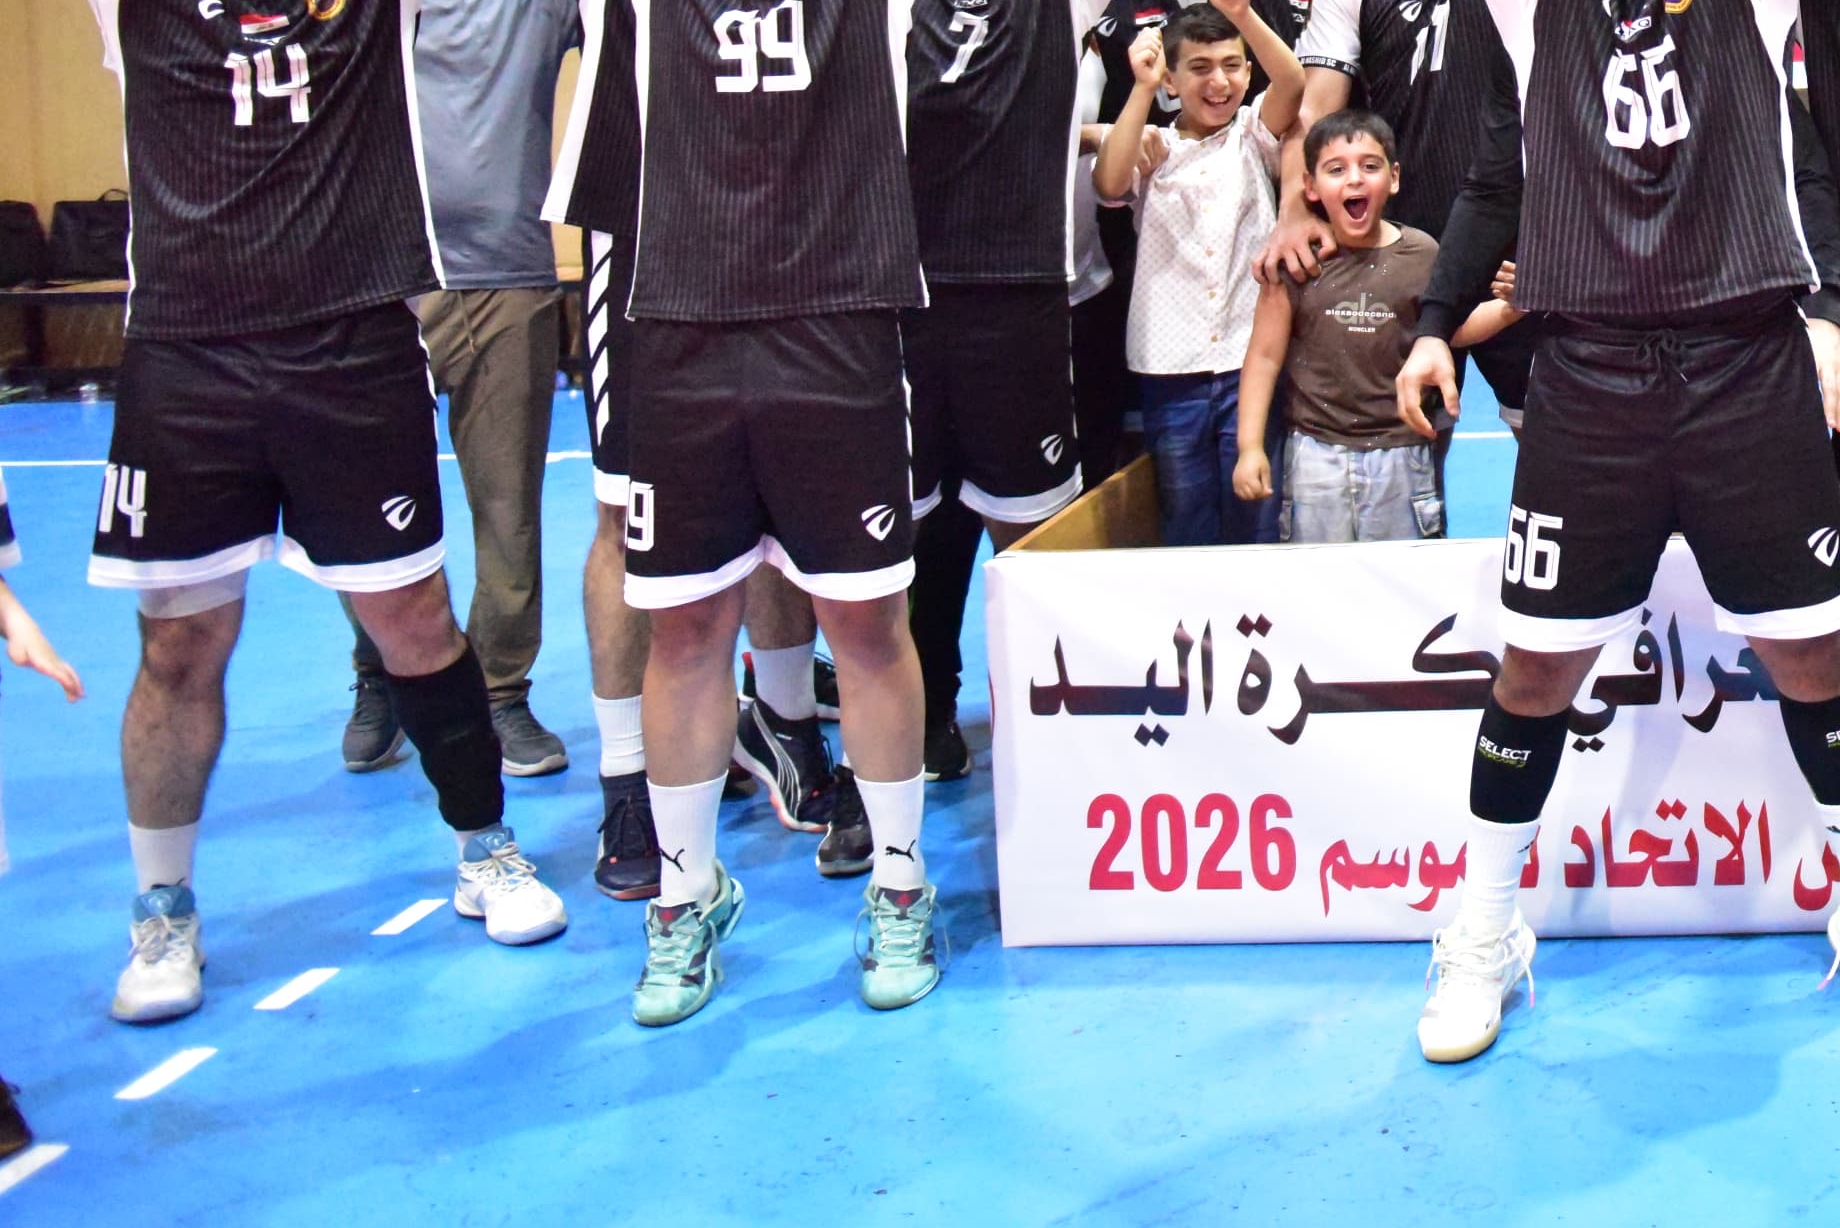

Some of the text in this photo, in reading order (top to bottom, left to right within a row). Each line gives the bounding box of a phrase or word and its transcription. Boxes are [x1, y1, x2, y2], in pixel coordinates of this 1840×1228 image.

[223, 42, 312, 126] 14
[948, 11, 991, 83] 7
[1603, 34, 1691, 150] 66
[99, 463, 148, 538] 14
[627, 480, 655, 552] 9
[1505, 503, 1564, 590] 66
[1030, 618, 1215, 747] اليد
[1236, 613, 1501, 745] كرة
[1566, 607, 1783, 753] عراقي
[1479, 735, 1532, 761] SELECT
[1086, 793, 1298, 893] 2026
[1563, 798, 1773, 889] الاتحاد
